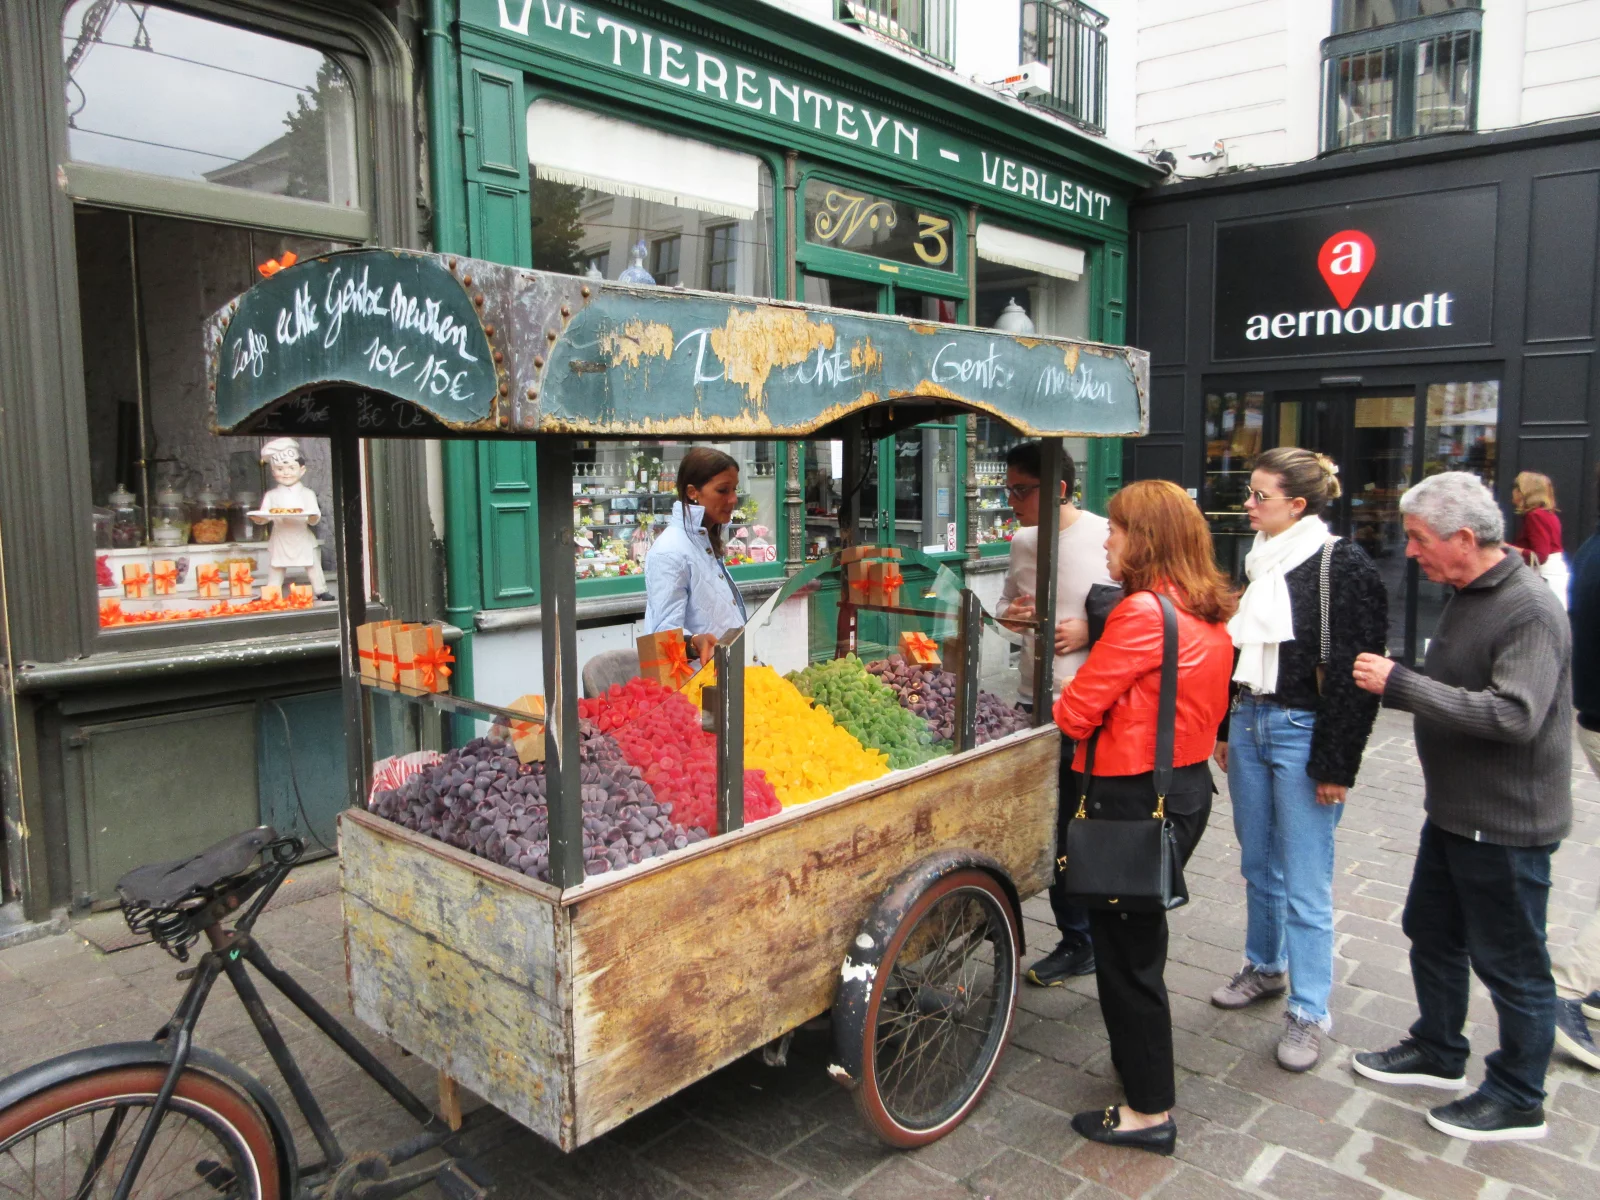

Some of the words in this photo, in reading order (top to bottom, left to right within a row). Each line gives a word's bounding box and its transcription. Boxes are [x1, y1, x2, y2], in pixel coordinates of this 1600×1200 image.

[597, 17, 919, 161] TIERENTEYN
[980, 151, 1111, 221] VERLENT
[913, 213, 950, 265] 3
[1330, 240, 1362, 276] a
[1245, 292, 1453, 341] aernoudt
[363, 336, 415, 379] 10€
[414, 354, 475, 402] 15€
